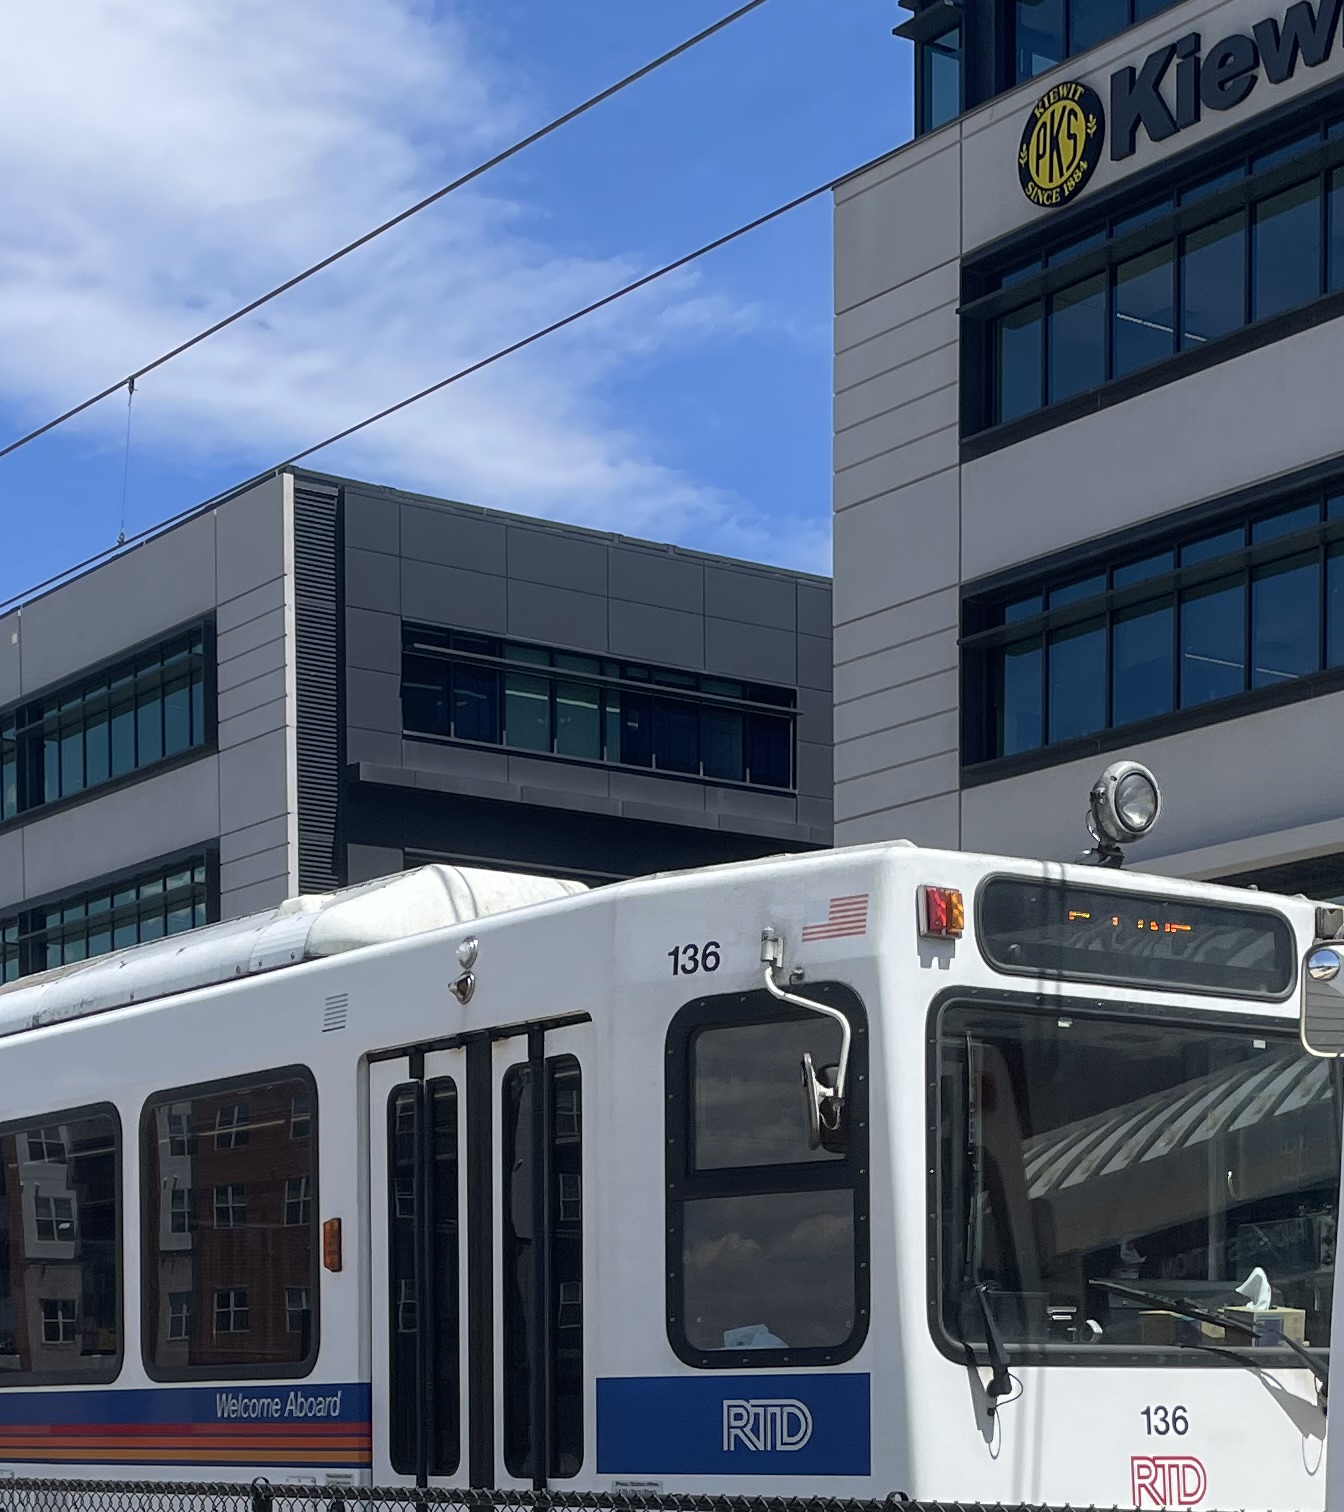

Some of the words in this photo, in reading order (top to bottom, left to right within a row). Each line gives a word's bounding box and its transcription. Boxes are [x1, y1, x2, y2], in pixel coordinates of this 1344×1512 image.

[1033, 83, 1085, 118] KIEWIT
[1035, 105, 1078, 184] PKS
[1025, 181, 1061, 205] SINCE
[1063, 161, 1088, 196] 1884
[667, 940, 721, 976] 136
[216, 1393, 282, 1418] Welcome
[284, 1390, 342, 1417] Aboard
[1141, 1405, 1189, 1436] 136
[722, 1399, 813, 1451] RTD
[1131, 1455, 1207, 1506] RTD
